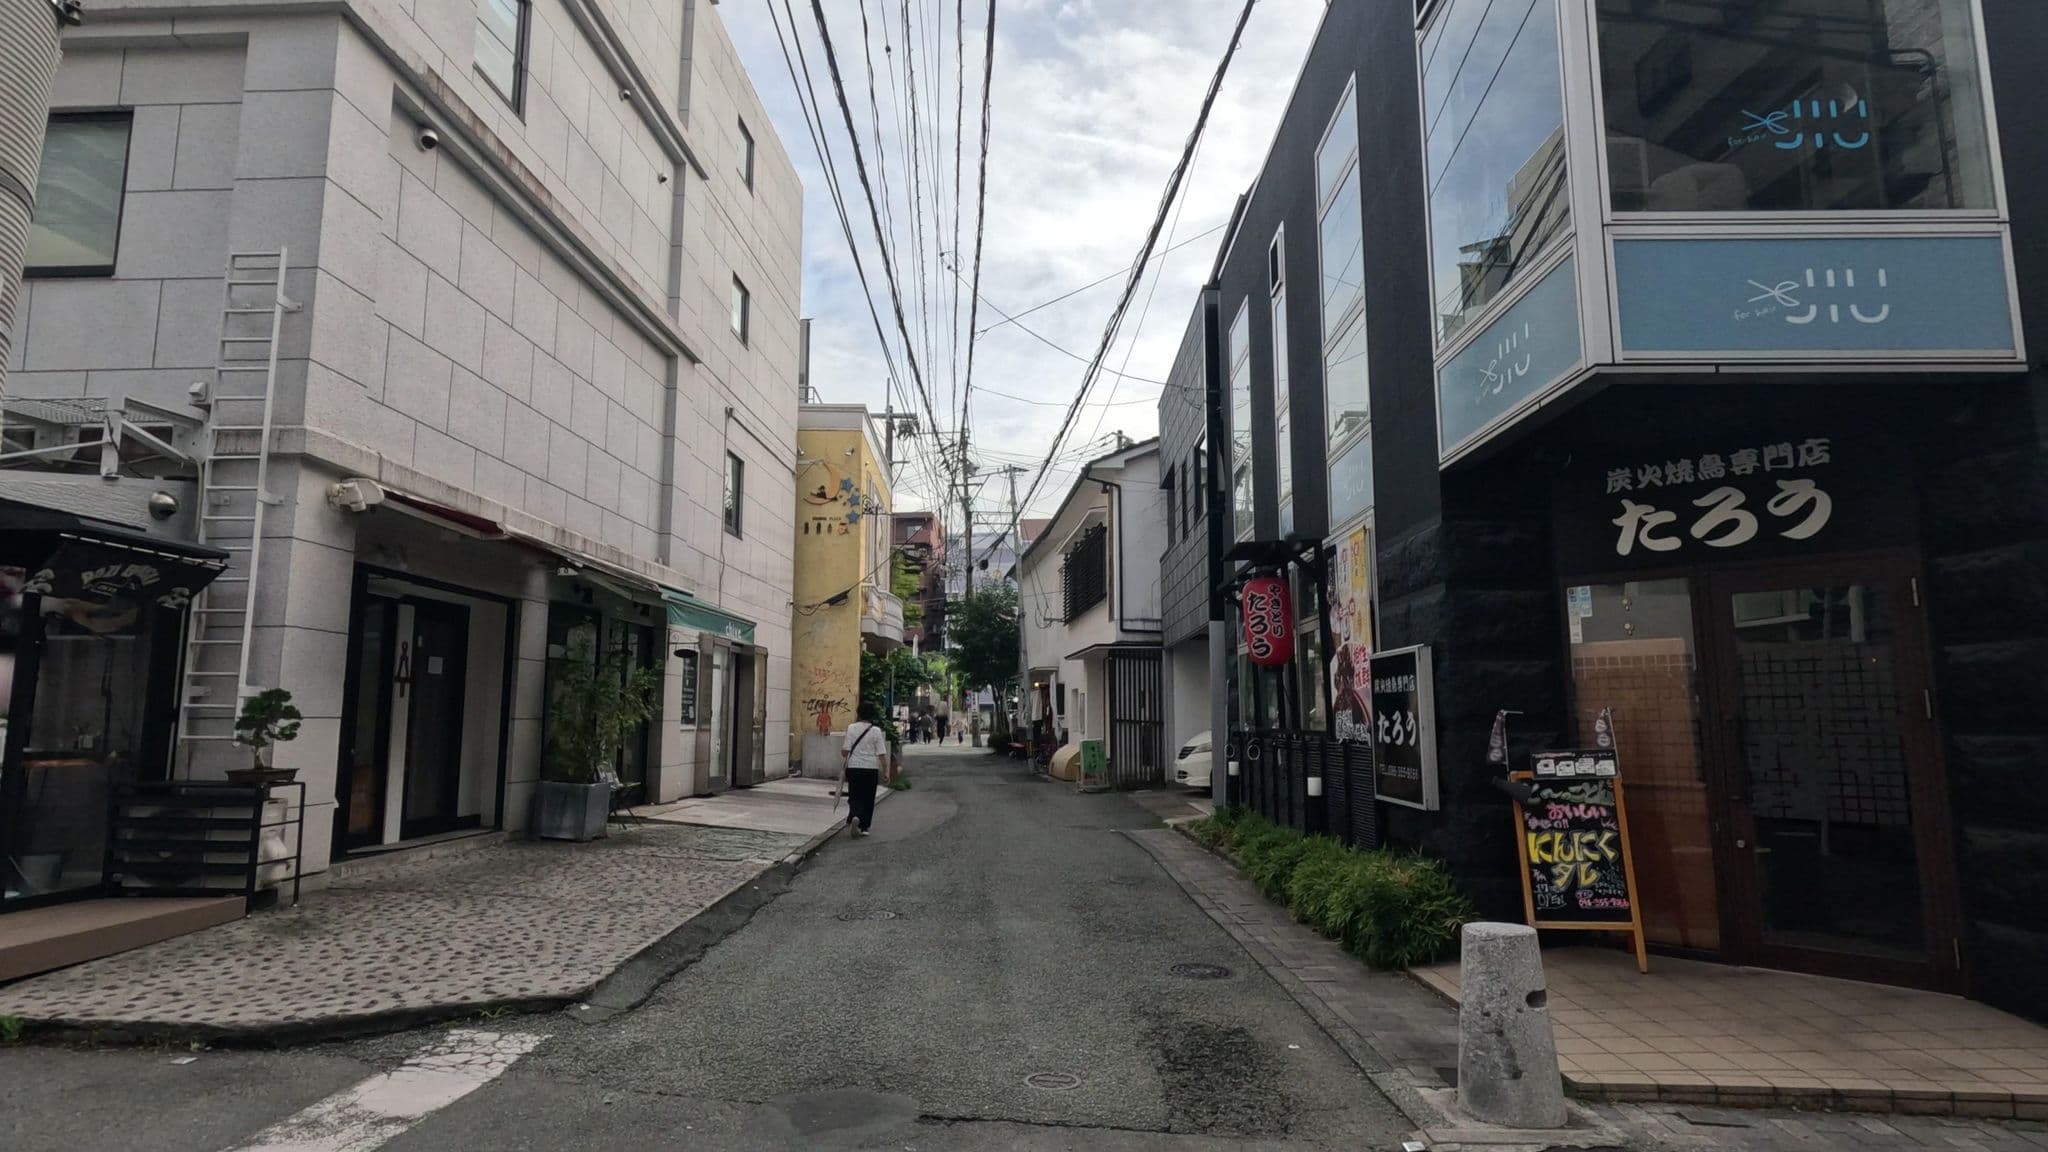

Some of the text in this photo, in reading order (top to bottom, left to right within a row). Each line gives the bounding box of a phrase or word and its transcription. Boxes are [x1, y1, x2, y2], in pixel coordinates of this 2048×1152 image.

[1785, 268, 1890, 324] JIU
[1605, 437, 1832, 495] 炭火焼鳥専門店
[1611, 478, 1833, 556] たろう
[1247, 592, 1272, 659] たろう
[1268, 584, 1285, 639] やきとり
[1377, 711, 1417, 747] たろう
[1527, 831, 1618, 864] にんにく
